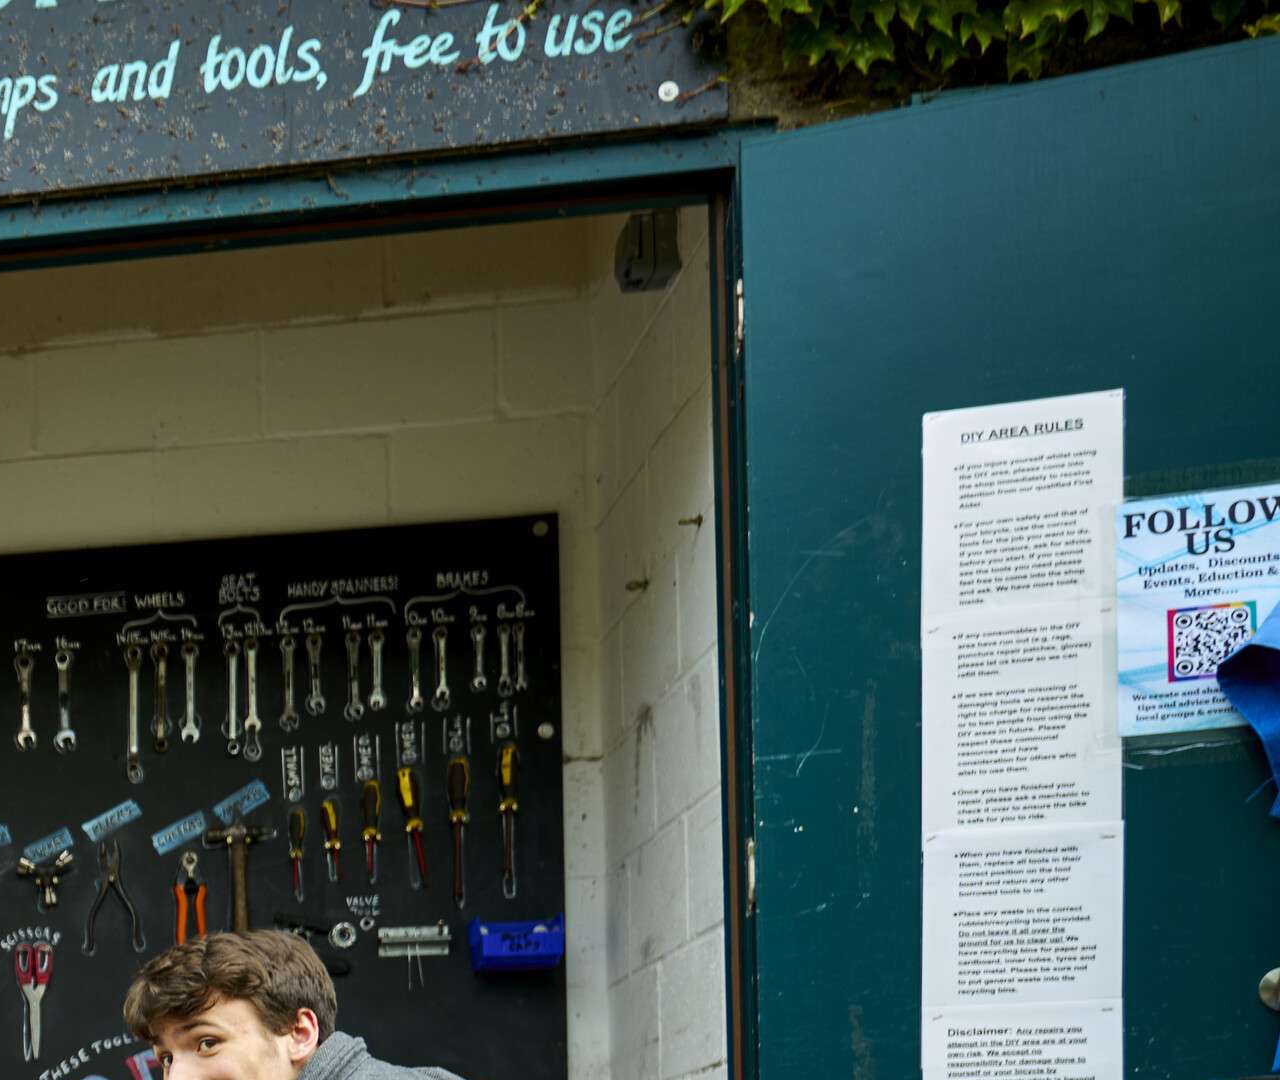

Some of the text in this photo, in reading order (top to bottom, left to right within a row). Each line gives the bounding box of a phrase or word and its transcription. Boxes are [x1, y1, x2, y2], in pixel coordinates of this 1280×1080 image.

[91, 39, 180, 103] and
[200, 25, 327, 94] tools,
[353, 8, 460, 98] free
[476, 3, 526, 64] to
[545, 9, 633, 58] use
[960, 418, 1084, 444] DIY AREA RULES
[973, 470, 987, 478] DIY
[1185, 528, 1236, 556] US
[1138, 561, 1200, 578] Updates,
[437, 569, 488, 589] BRAKES
[1143, 566, 1278, 591] Events, Eduction &
[219, 587, 260, 605] BOLTS
[288, 581, 328, 597] HANDY
[46, 598, 89, 614] GOOD
[134, 592, 184, 608] WHEELS
[1131, 693, 1147, 702] We
[1148, 690, 1180, 700] create
[1181, 687, 1200, 698] and
[1137, 701, 1156, 713] tips
[1158, 699, 1177, 709] and
[1178, 697, 1211, 708] advice
[1136, 711, 1158, 722] local
[1160, 708, 1195, 721] groups
[346, 895, 380, 907] VALVE
[0, 925, 62, 951] SCISSORS
[1016, 1028, 1032, 1036] Any
